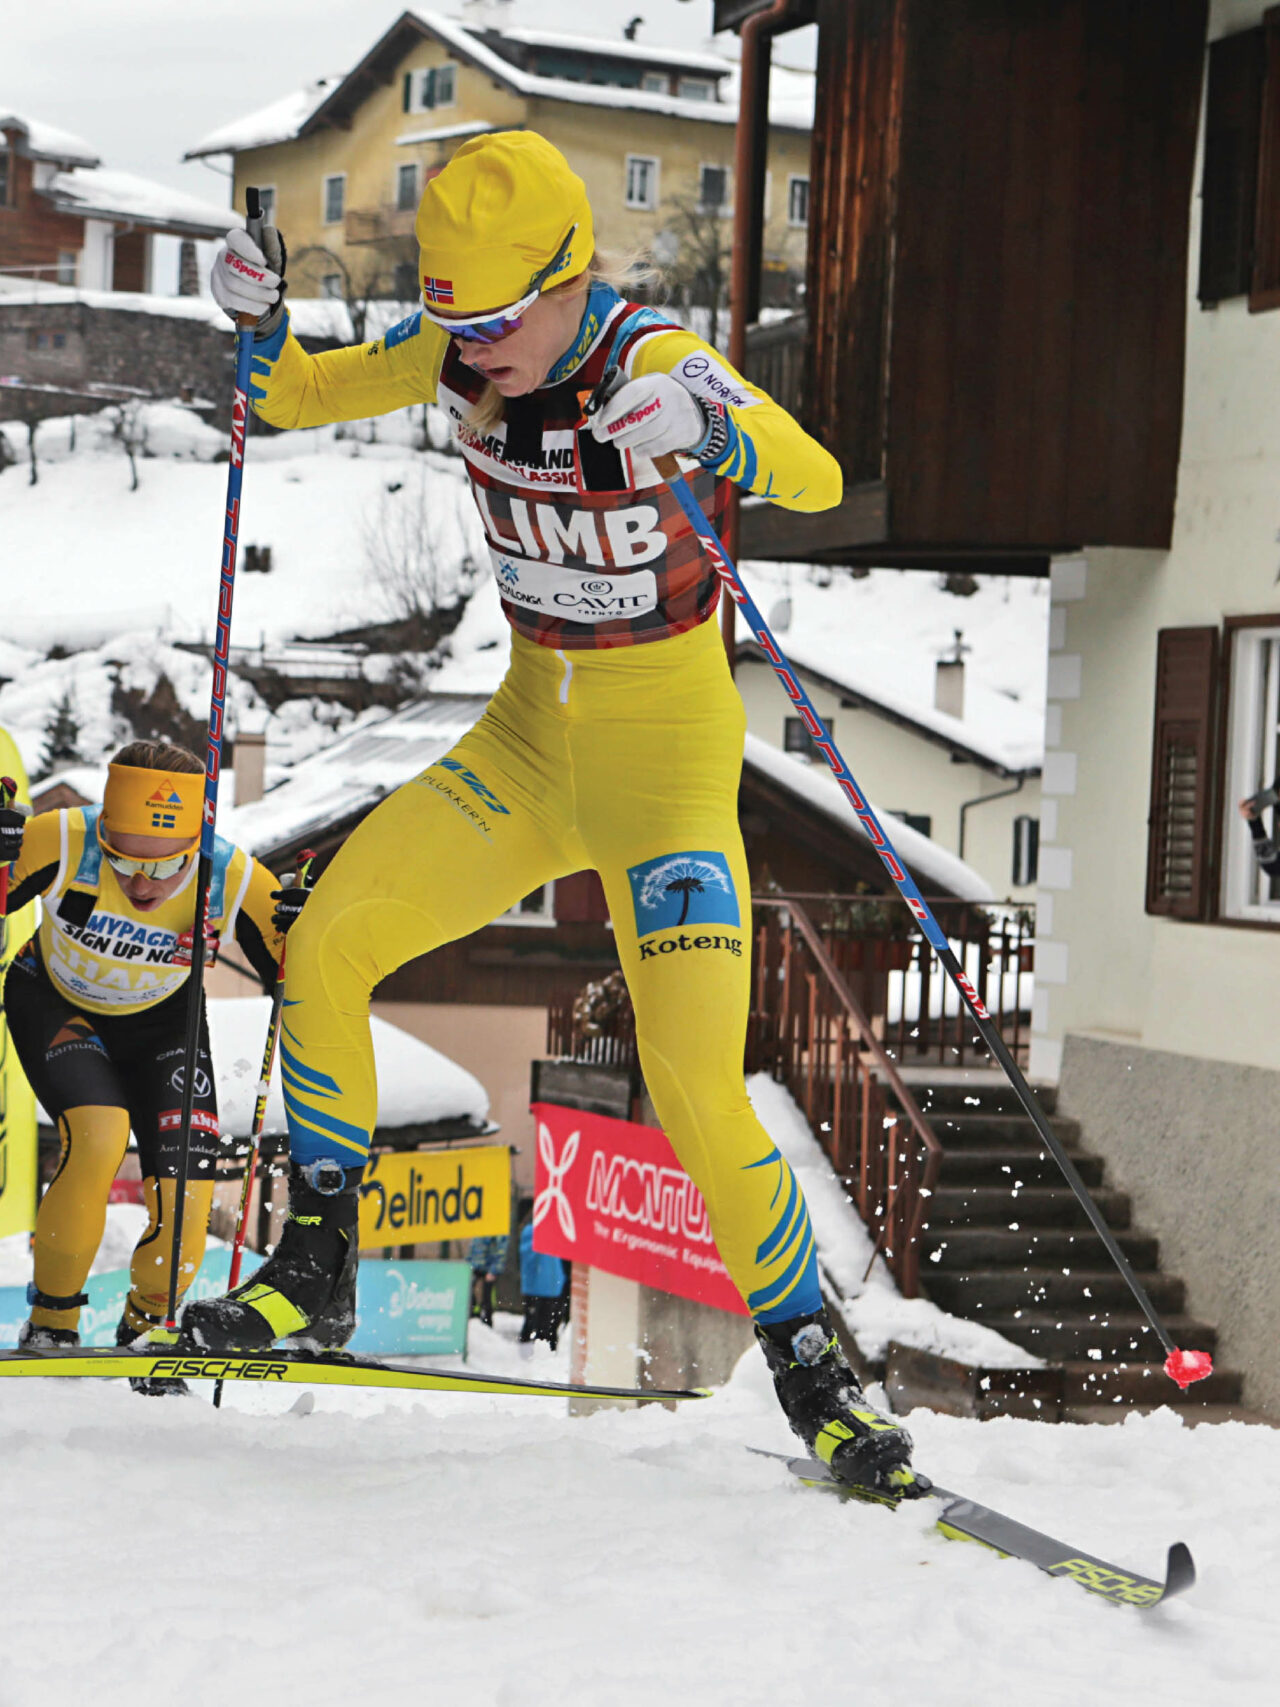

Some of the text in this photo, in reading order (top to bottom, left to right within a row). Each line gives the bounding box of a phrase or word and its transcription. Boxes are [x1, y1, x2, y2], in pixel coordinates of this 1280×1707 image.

[474, 484, 668, 568] LIMB
[552, 593, 648, 610] CAVIT
[62, 924, 111, 953] SIGN
[112, 940, 144, 960] UP
[146, 950, 173, 965] NO
[639, 934, 743, 962] Koteng
[149, 1359, 289, 1380] FISCHER
